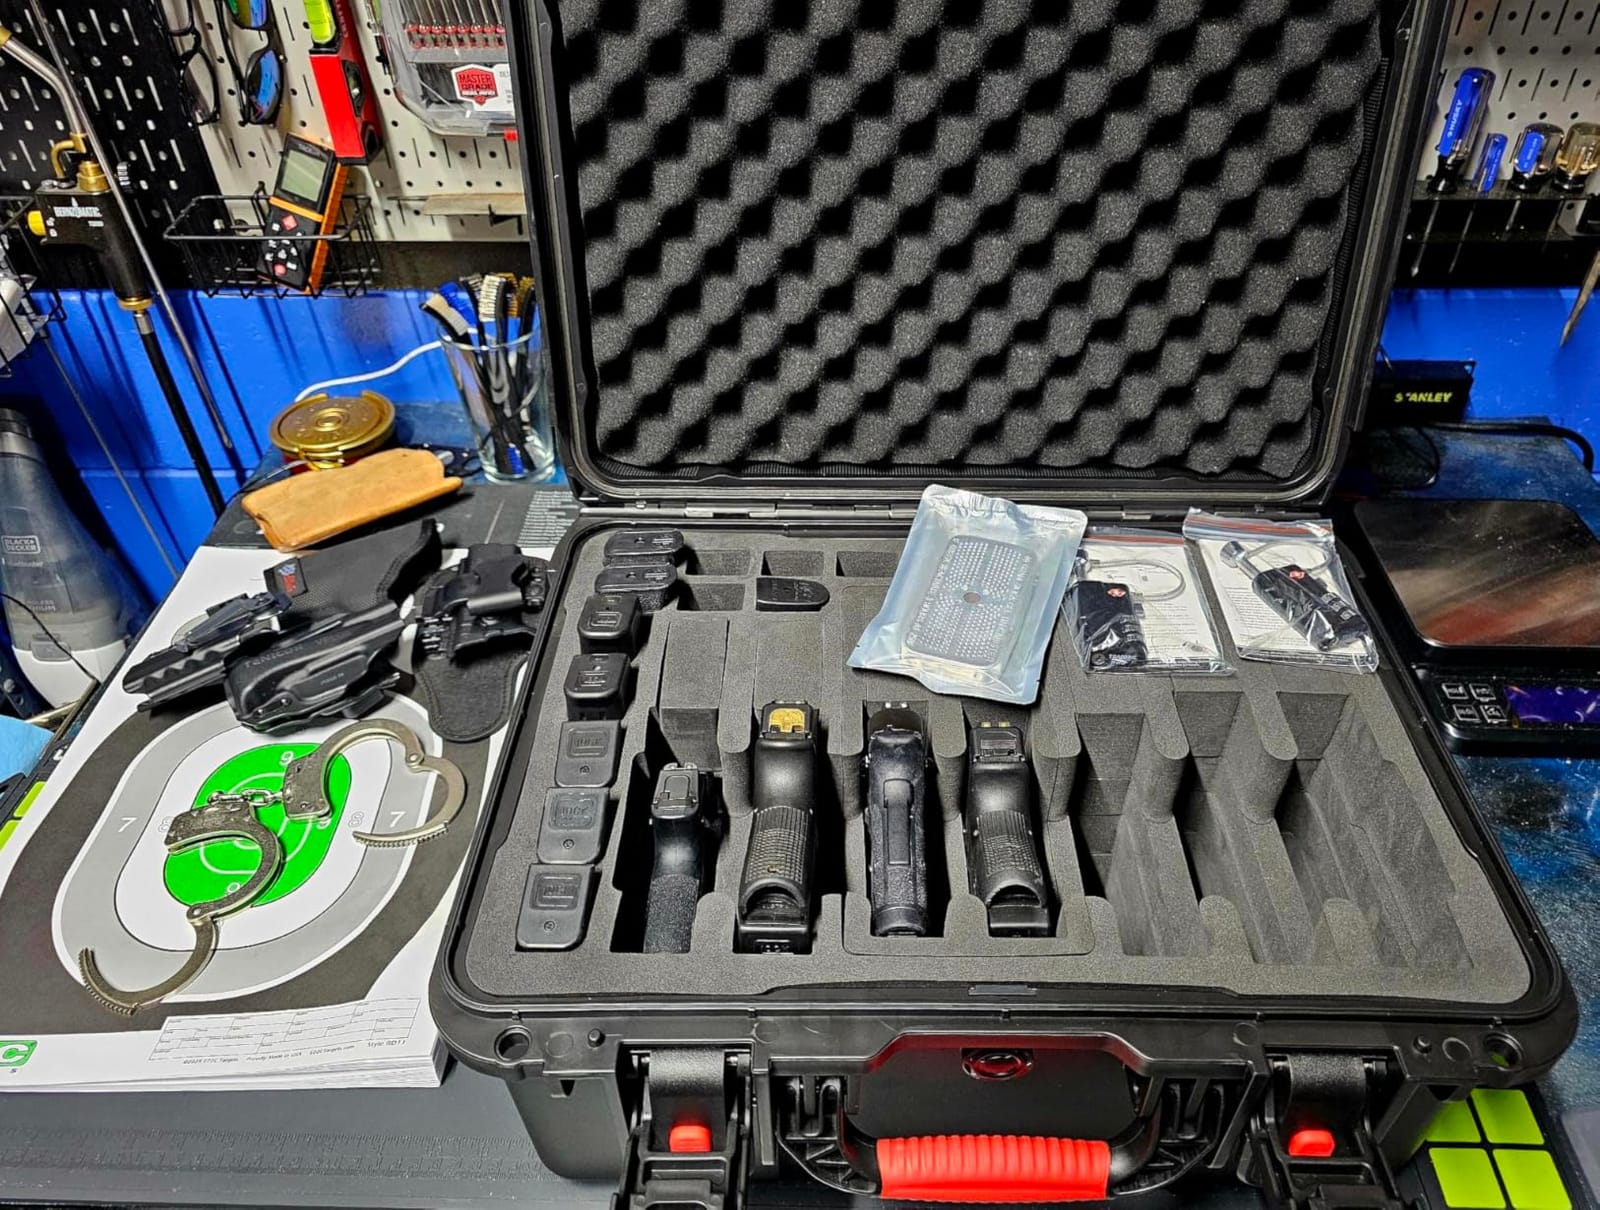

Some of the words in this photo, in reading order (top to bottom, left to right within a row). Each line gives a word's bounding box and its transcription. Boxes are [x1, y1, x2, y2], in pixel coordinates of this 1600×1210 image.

[458, 73, 492, 83] MASTER
[1449, 99, 1463, 131] HUSKY
[118, 817, 137, 833] 7
[390, 811, 406, 827] 7
